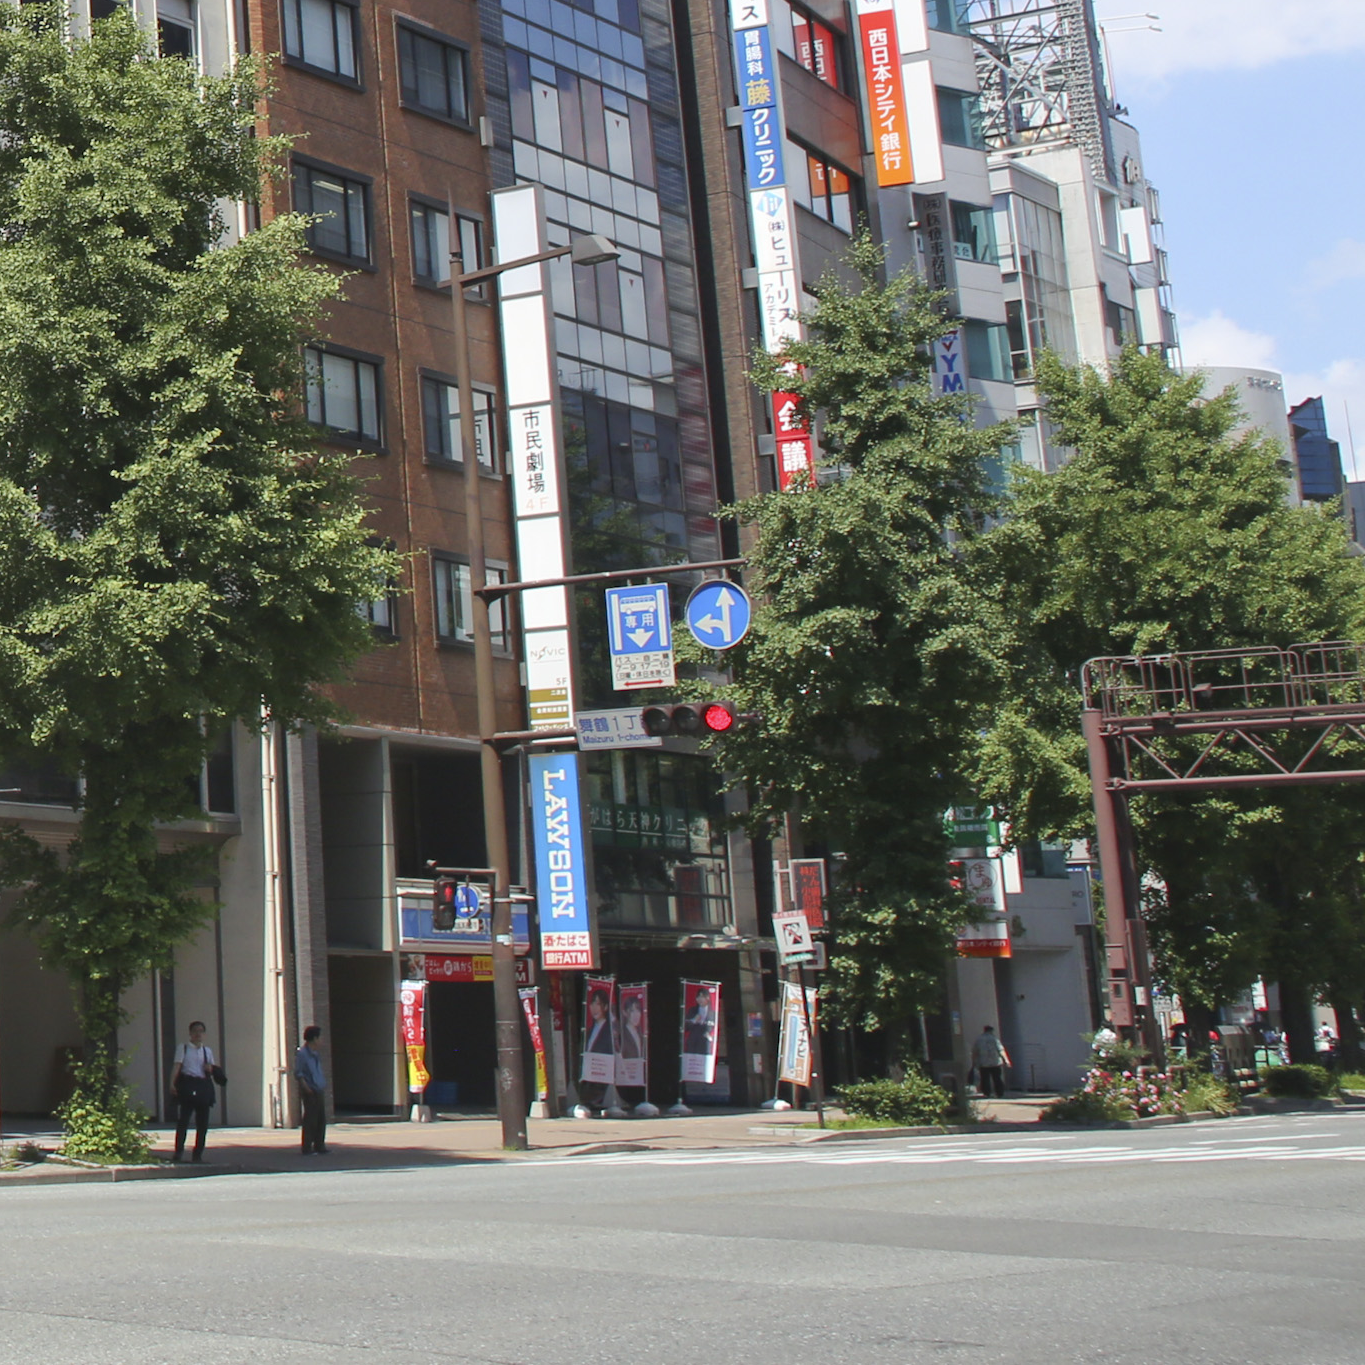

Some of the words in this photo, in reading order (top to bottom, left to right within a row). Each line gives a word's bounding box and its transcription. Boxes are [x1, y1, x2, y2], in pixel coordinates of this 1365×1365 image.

[743, 30, 766, 76] 胃腸科
[867, 27, 903, 172] 西日本シティ銀行
[752, 108, 777, 185] クリニック
[522, 410, 546, 494] 市民劇場
[624, 612, 655, 629] 専用
[578, 713, 646, 734] 舞鶴1丁
[582, 735, 615, 746] Maizuru
[542, 768, 576, 920] LAWSON
[543, 934, 588, 948] 酒・たばこ
[545, 951, 589, 965] 銀行ATM
